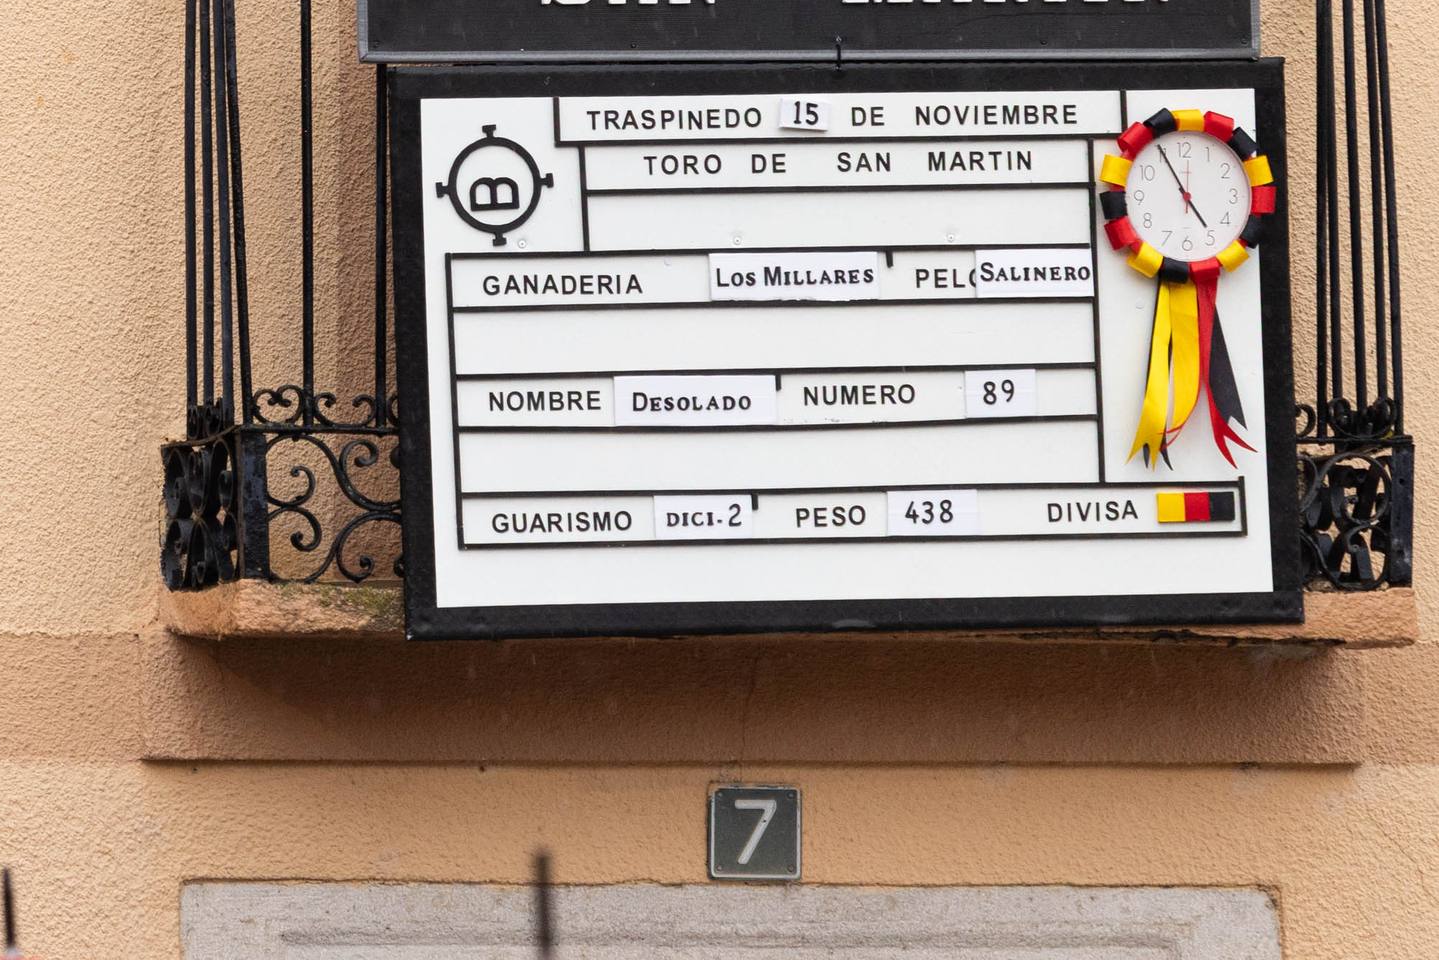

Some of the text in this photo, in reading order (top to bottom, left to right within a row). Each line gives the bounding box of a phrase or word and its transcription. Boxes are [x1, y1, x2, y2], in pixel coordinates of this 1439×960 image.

[586, 101, 1078, 130] TRASPINEDO 15 DE NOVIEMBRE
[1176, 141, 1192, 158] 12
[643, 150, 1032, 176] TORO DE SAN MARTIN
[1221, 162, 1231, 179] 2
[1140, 165, 1155, 181] 10
[1134, 191, 1144, 205] 9
[1229, 188, 1239, 205] 3
[1142, 212, 1153, 229] 8
[1220, 212, 1231, 227] 4
[1162, 230, 1172, 245] 7
[1181, 236, 1193, 252] 6
[1205, 230, 1216, 247] 5
[482, 274, 643, 296] GANADERIA
[488, 390, 601, 412] NOMBRE
[803, 379, 1015, 406] NUMERO 89
[795, 499, 954, 528] PESO 438
[1047, 499, 1139, 523] DIVISA
[491, 510, 632, 534] GUARISMO
[734, 799, 777, 865] 7
